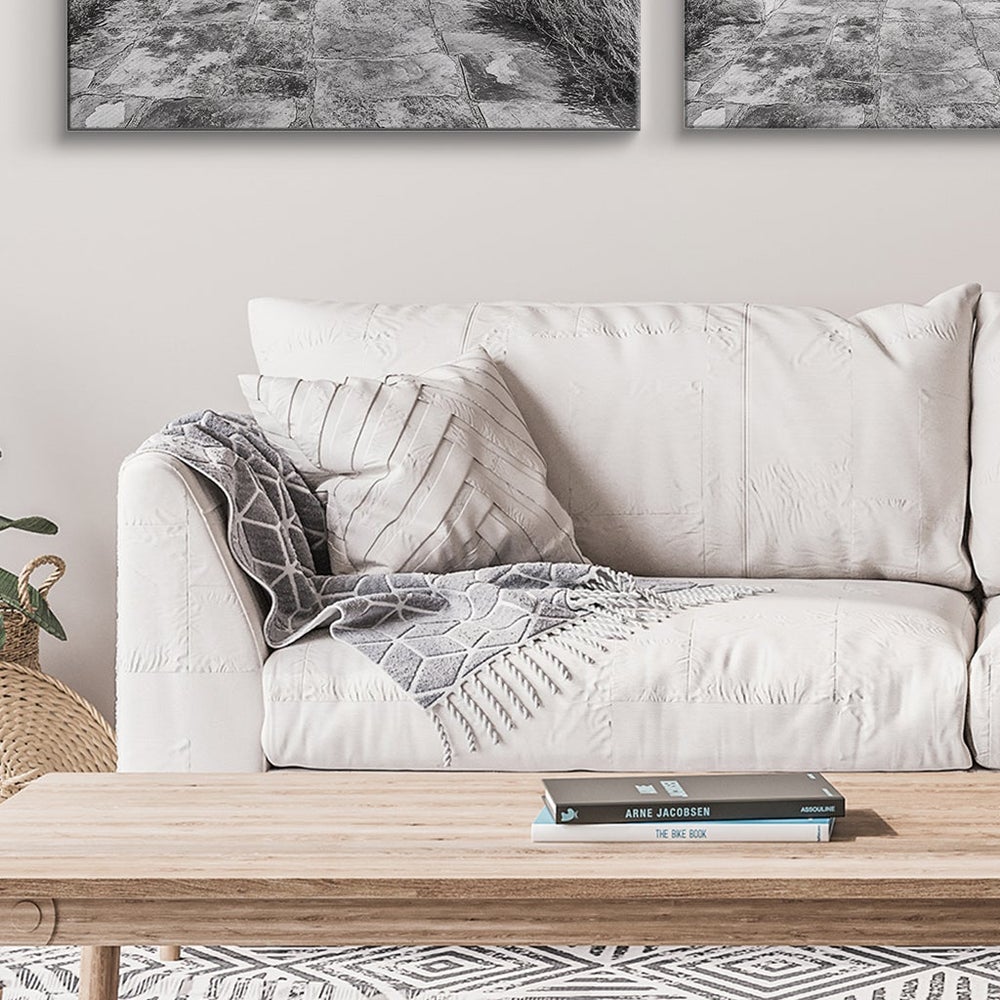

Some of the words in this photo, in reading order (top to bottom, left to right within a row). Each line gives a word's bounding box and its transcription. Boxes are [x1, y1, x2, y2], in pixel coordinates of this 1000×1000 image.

[625, 808, 653, 818] ARNE
[656, 807, 710, 817] JACOBSEN
[655, 829, 668, 838] THE
[671, 829, 686, 838] BIKE
[689, 829, 707, 838] BOOK
